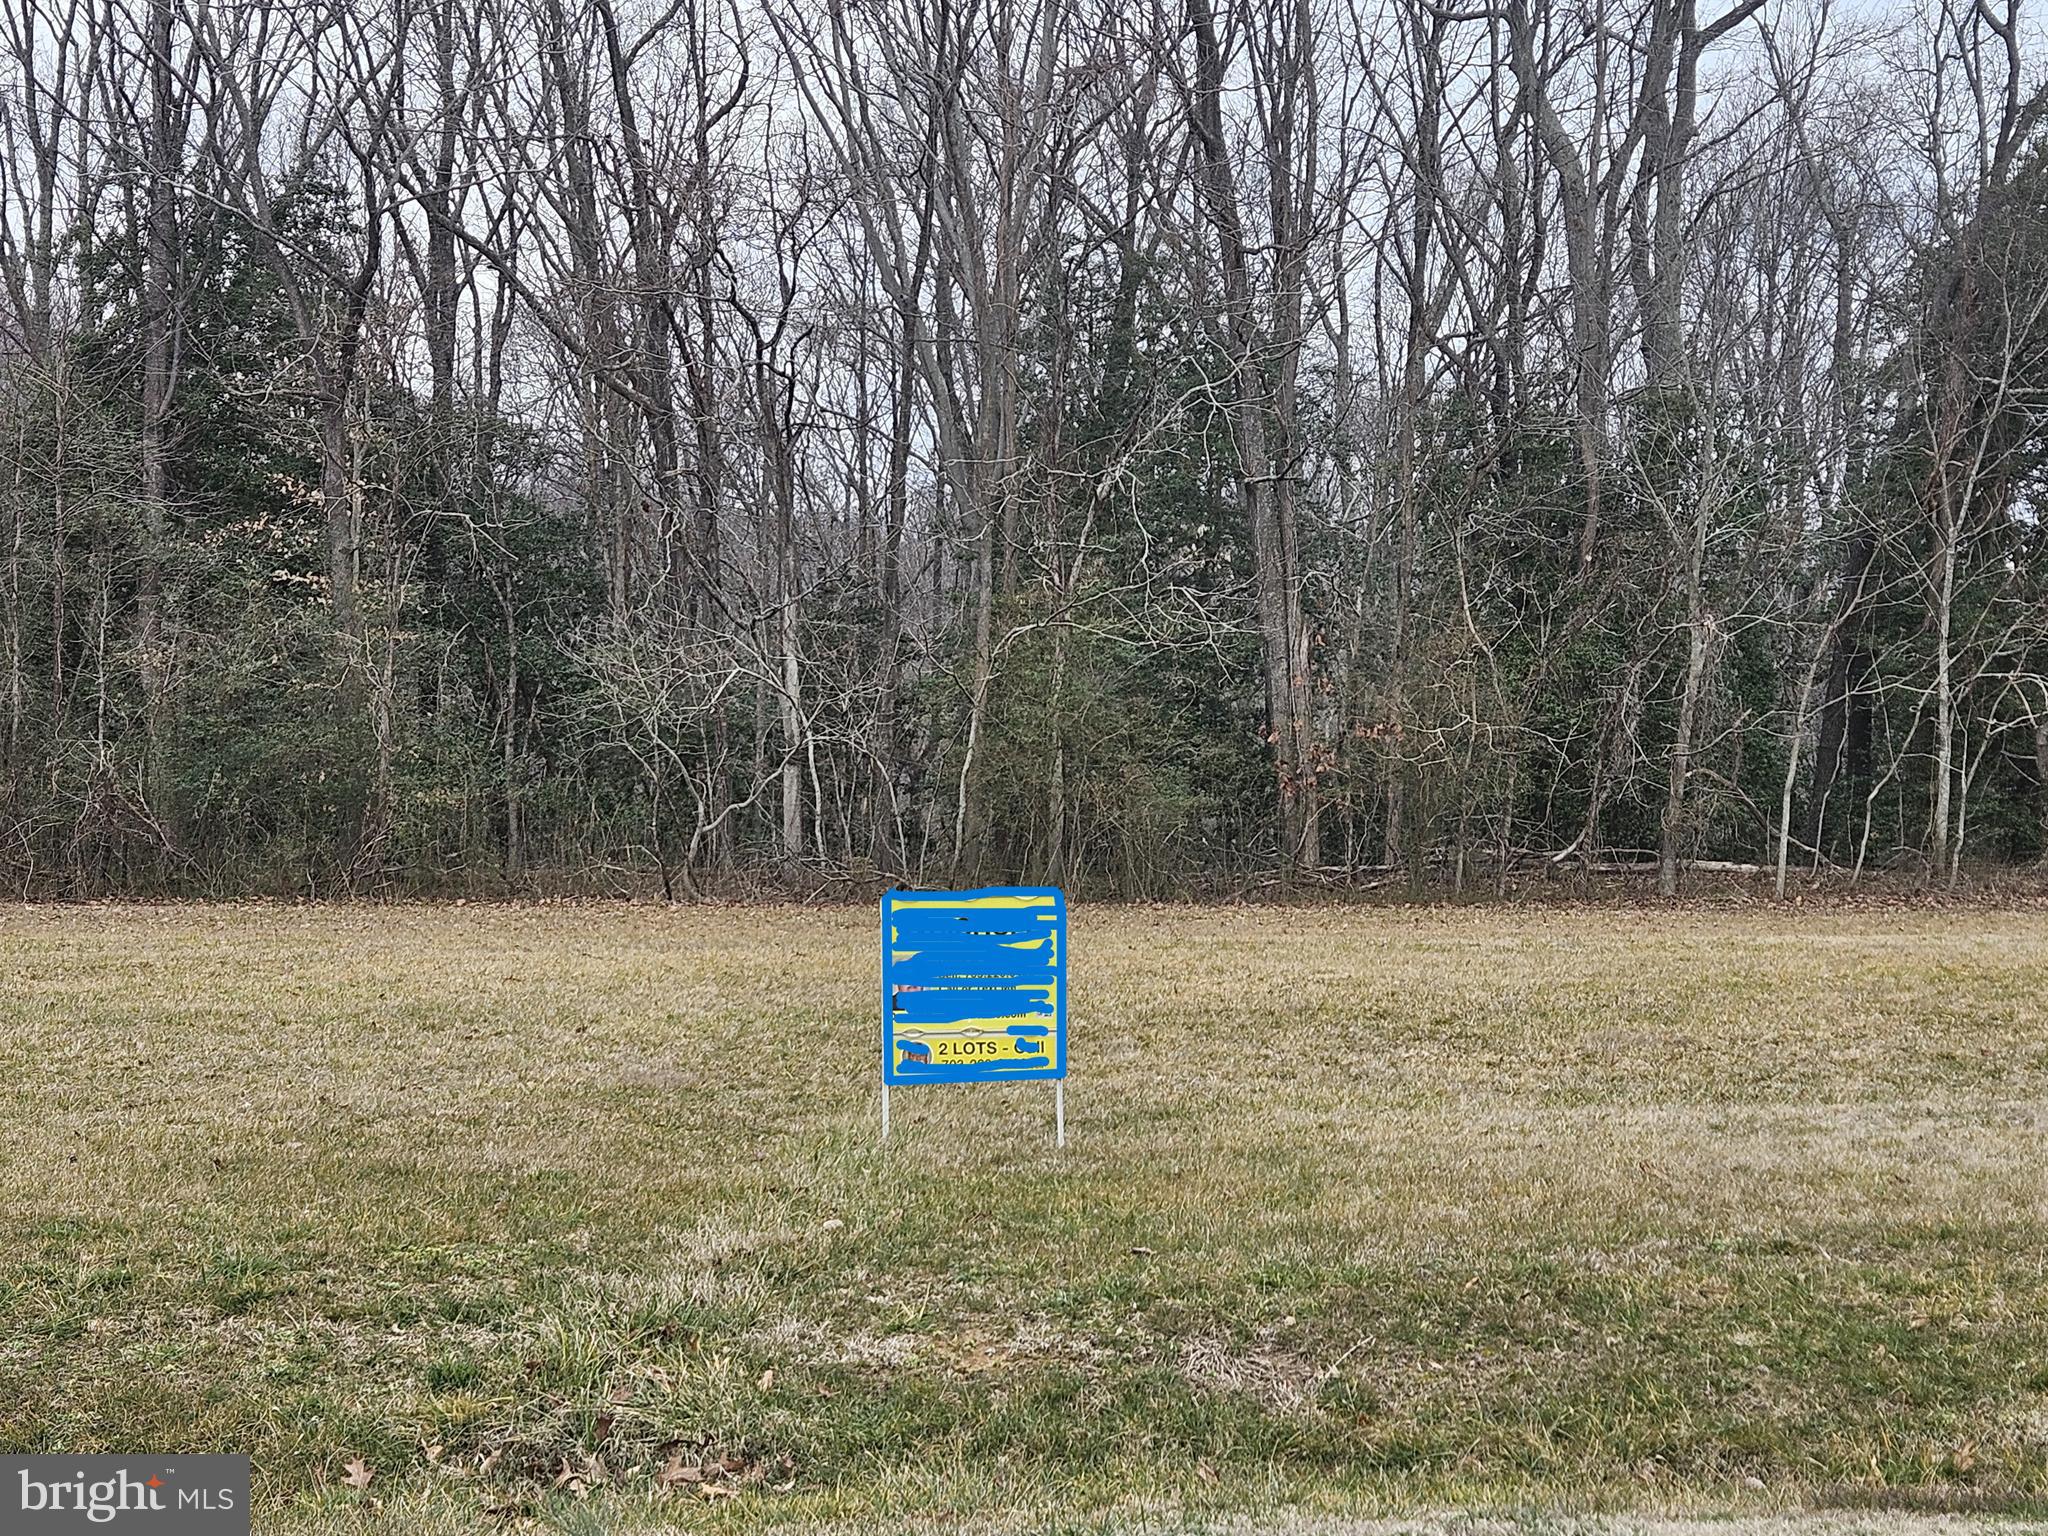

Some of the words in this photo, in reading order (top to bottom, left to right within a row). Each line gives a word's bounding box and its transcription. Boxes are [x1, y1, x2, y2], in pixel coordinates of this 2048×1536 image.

[938, 1043, 948, 1055] 2
[953, 1042, 997, 1055] LOTS
[1014, 1040, 1044, 1054] Cll
